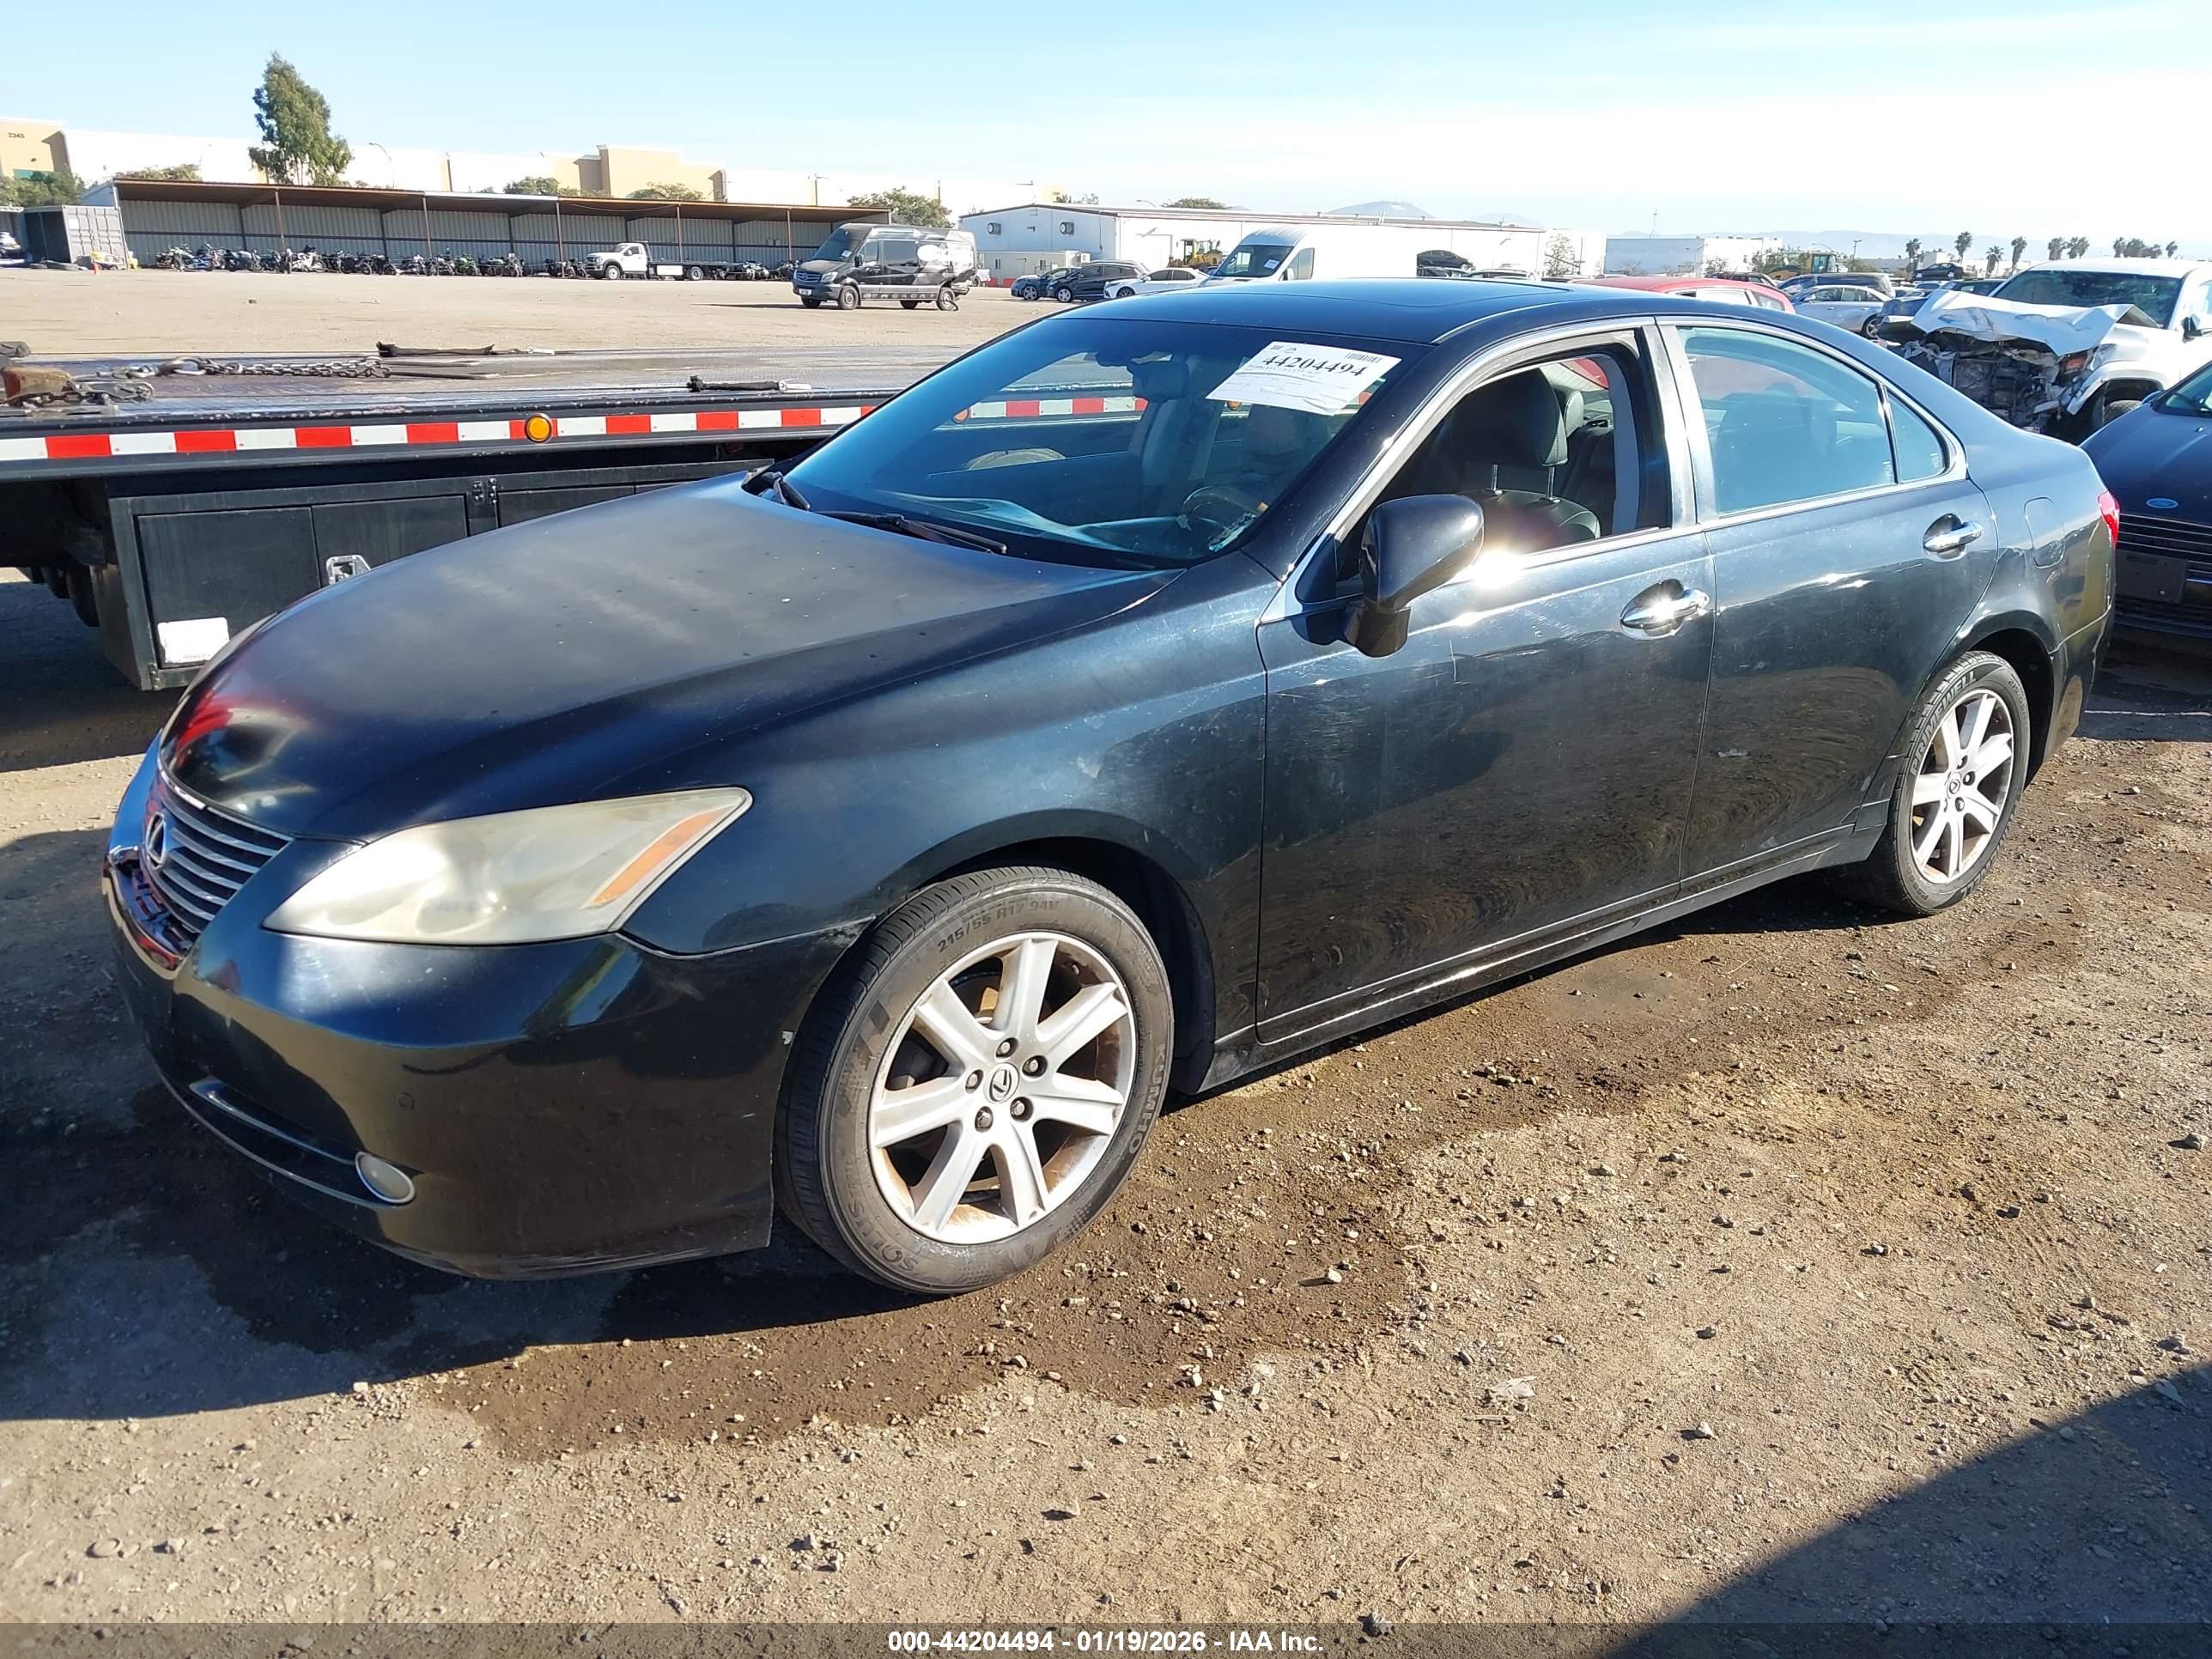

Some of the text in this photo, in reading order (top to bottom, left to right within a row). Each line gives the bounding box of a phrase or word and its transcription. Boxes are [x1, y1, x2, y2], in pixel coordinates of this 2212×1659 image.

[1262, 355, 1368, 376] 44204494
[1909, 670, 1977, 777] PRIMEWELL
[937, 913, 992, 954] 215/55
[996, 902, 1024, 921] R17
[1128, 1042, 1166, 1155] KUMHO
